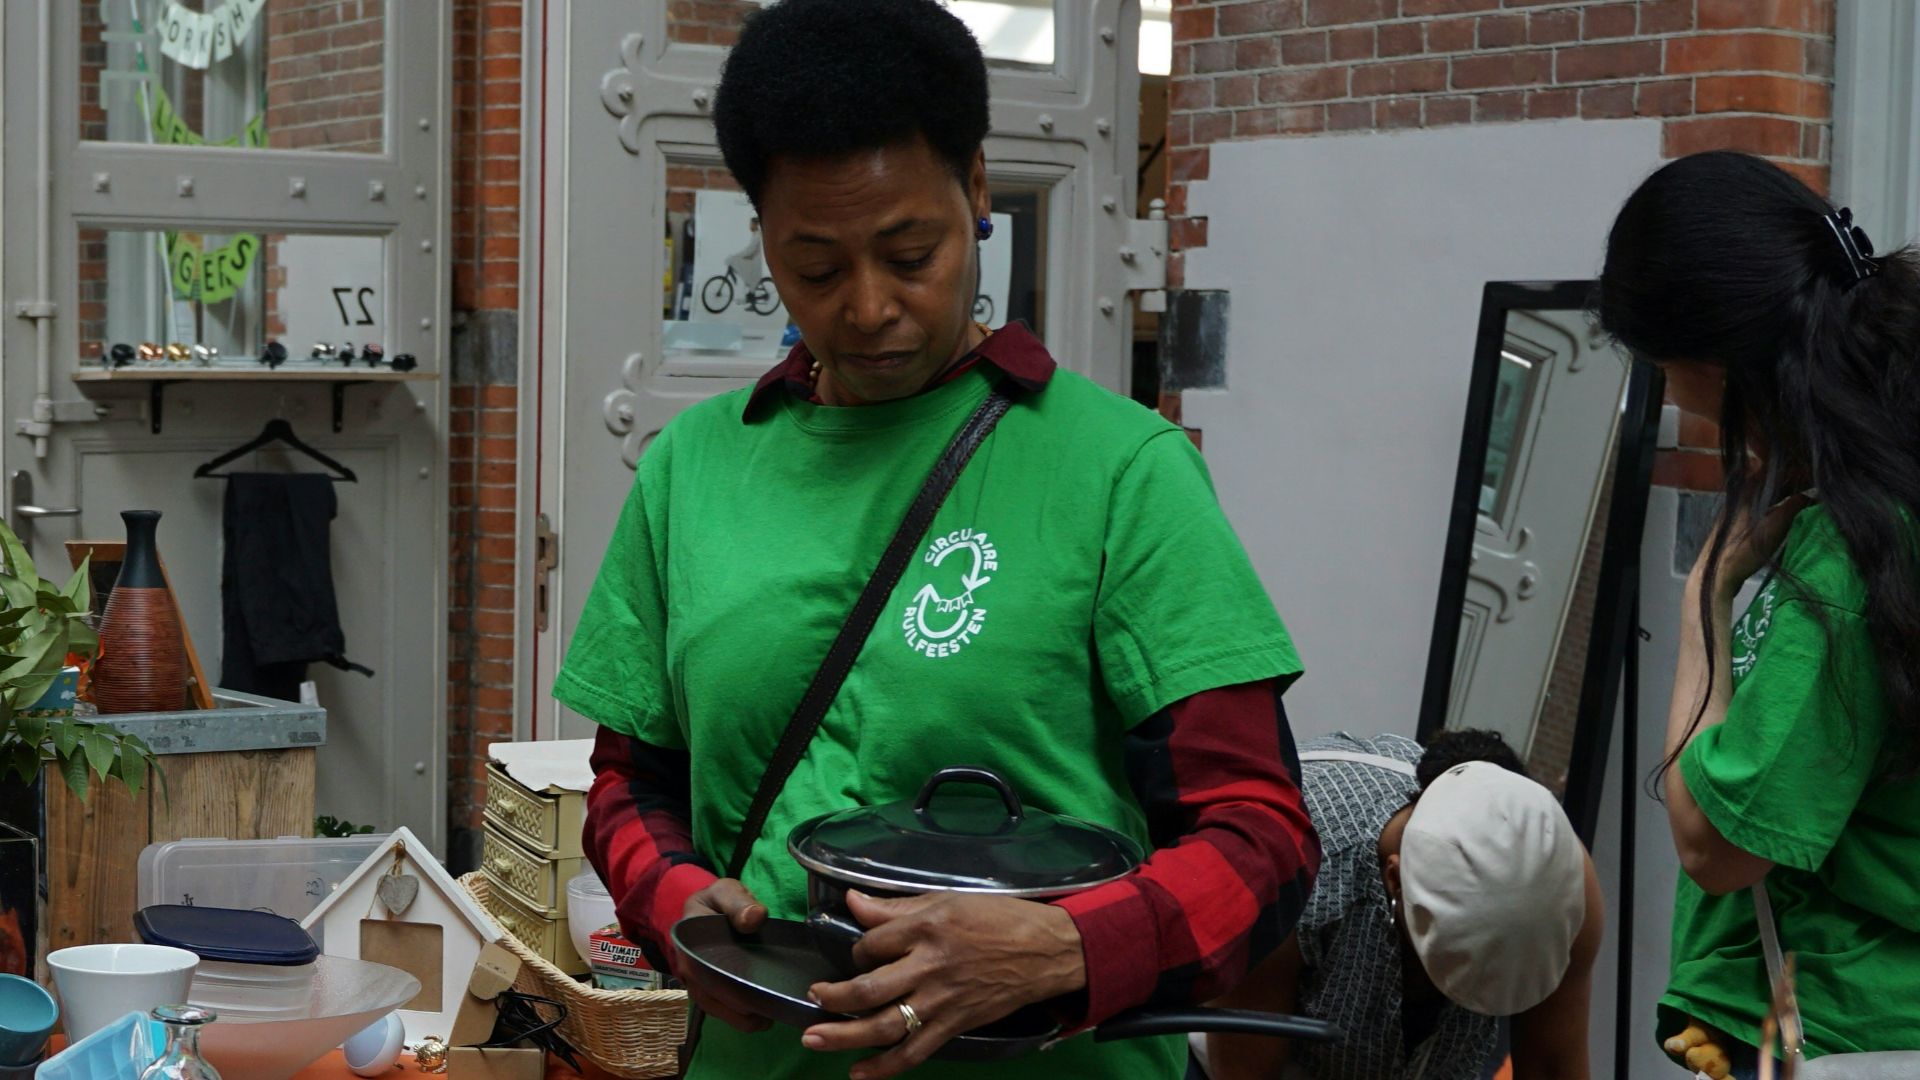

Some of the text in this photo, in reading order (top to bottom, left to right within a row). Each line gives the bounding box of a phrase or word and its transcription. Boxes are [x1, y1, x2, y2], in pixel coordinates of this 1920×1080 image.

[161, 0, 257, 53] ORKSH
[924, 527, 998, 571] CIRCUAIRE
[902, 606, 987, 658] RUILFEESTEN
[600, 941, 641, 957] ULTIMATE
[612, 953, 636, 965] SPEED
